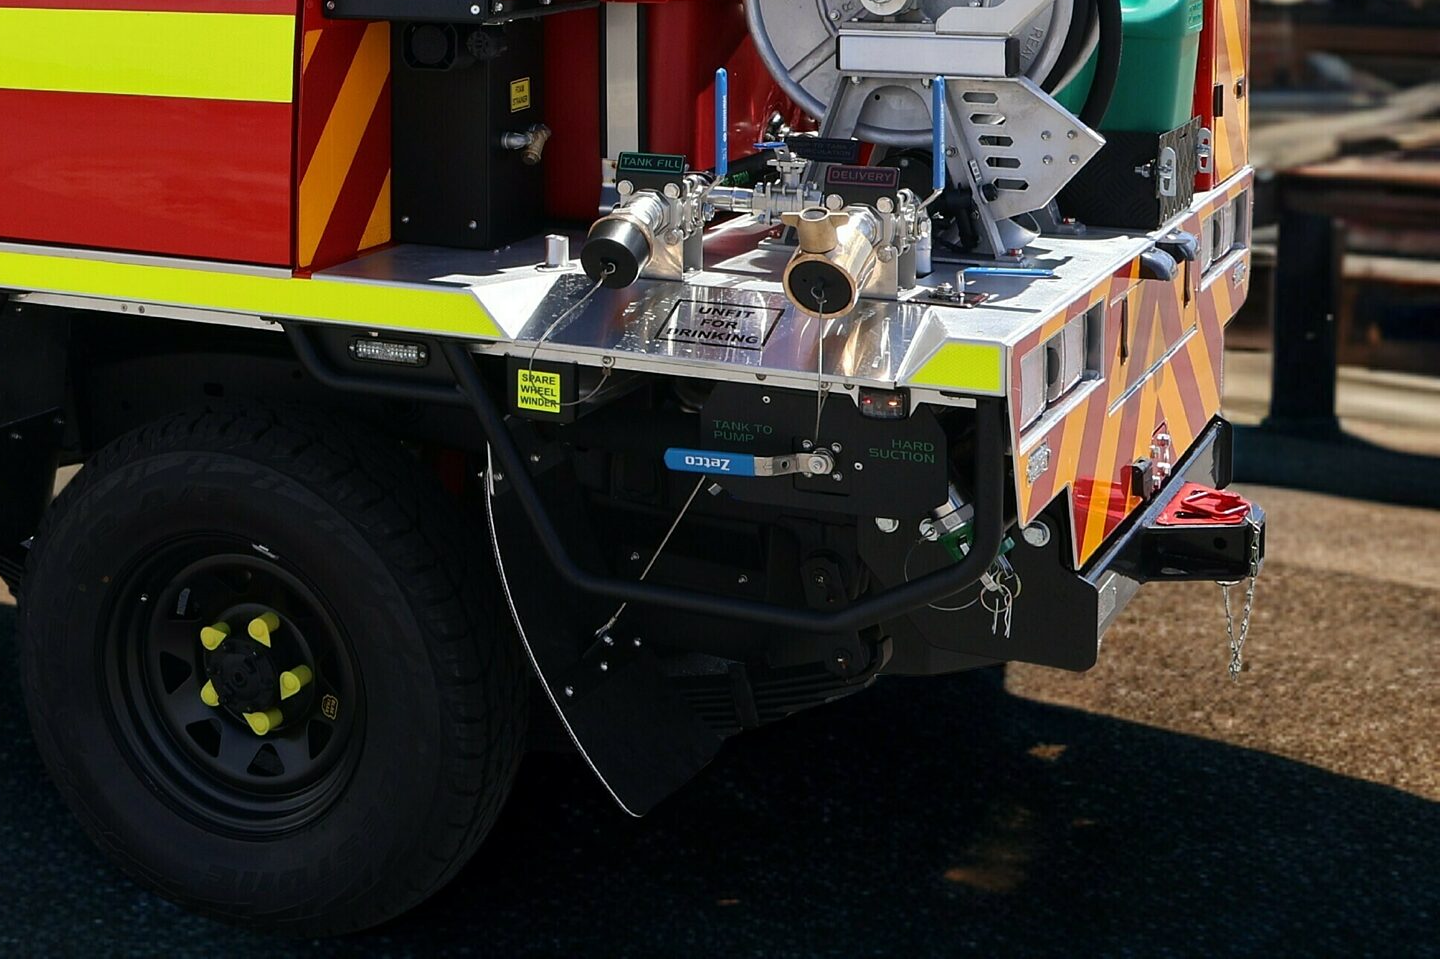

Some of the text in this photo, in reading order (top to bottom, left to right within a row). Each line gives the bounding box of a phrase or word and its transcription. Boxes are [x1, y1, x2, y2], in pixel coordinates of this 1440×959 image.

[622, 156, 681, 169] TANK FILL
[832, 170, 893, 182] DELIVERY
[698, 306, 755, 318] UNFIT
[700, 319, 738, 330] FOR
[666, 327, 759, 344] DRINKING
[521, 373, 556, 386] SPARE
[520, 384, 557, 397] WHEEL
[520, 395, 557, 408] WINDER
[713, 420, 773, 435] TANK TO
[713, 431, 754, 442] PUMP
[891, 439, 935, 452] HARD
[868, 447, 935, 464] SUCTION
[685, 455, 730, 471] Zetco
